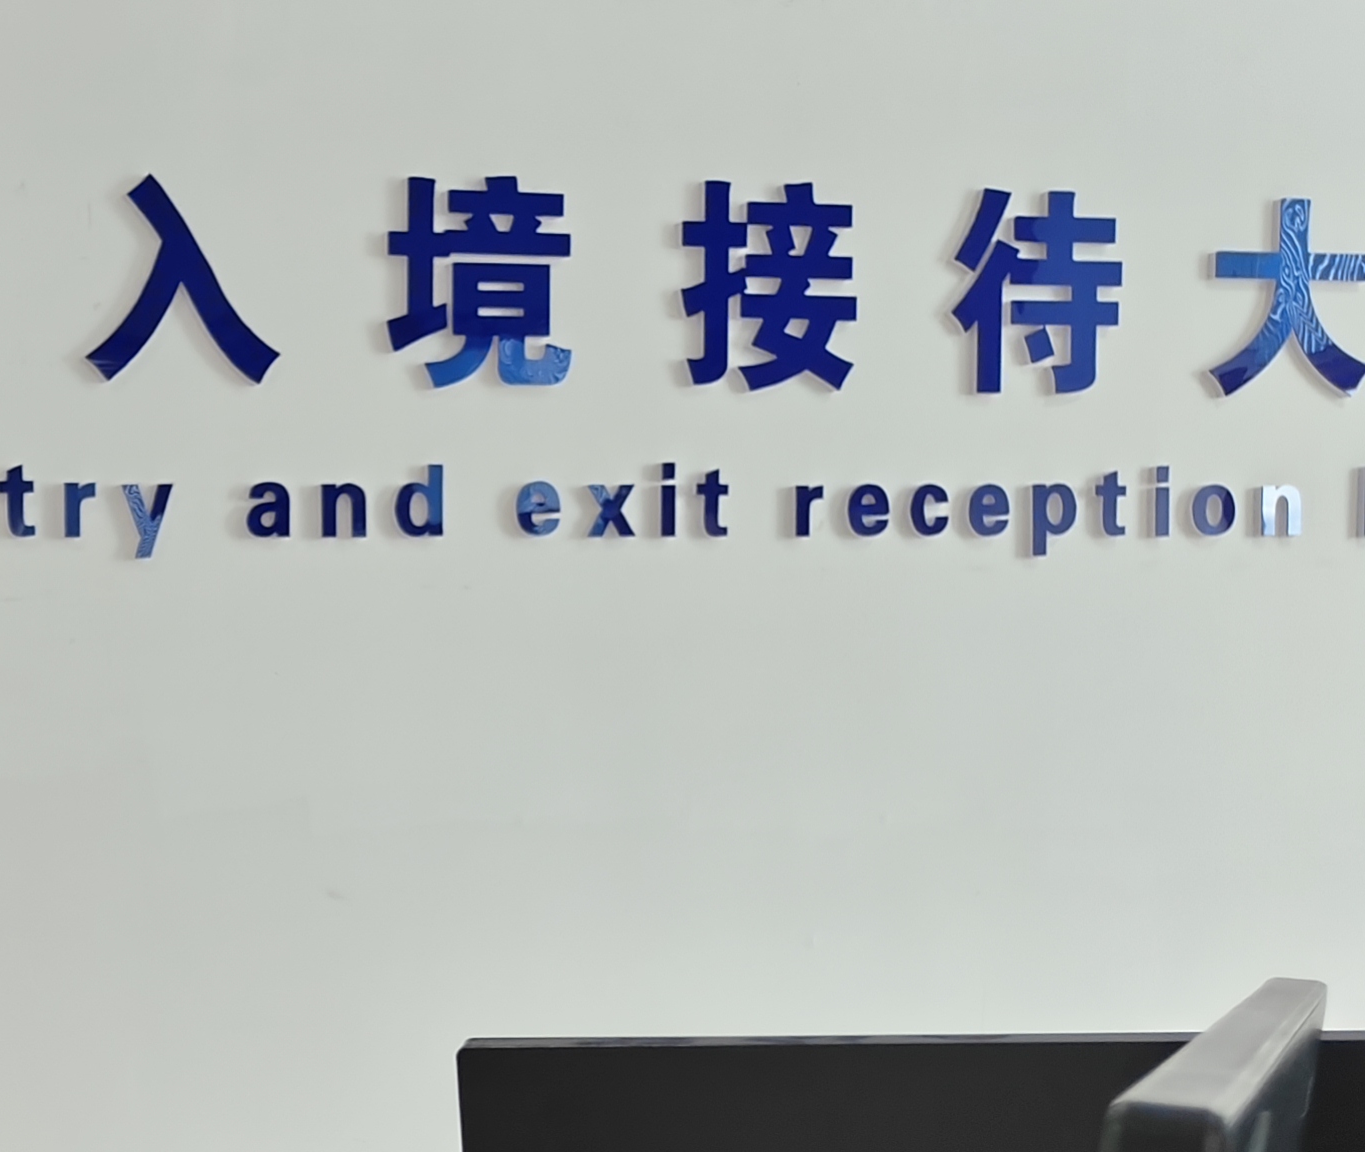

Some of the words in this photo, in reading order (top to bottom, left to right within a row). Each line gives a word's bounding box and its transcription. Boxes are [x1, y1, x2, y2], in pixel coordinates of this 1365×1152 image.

[246, 463, 445, 537] and
[516, 463, 729, 537] exit
[795, 465, 1303, 557] reception
